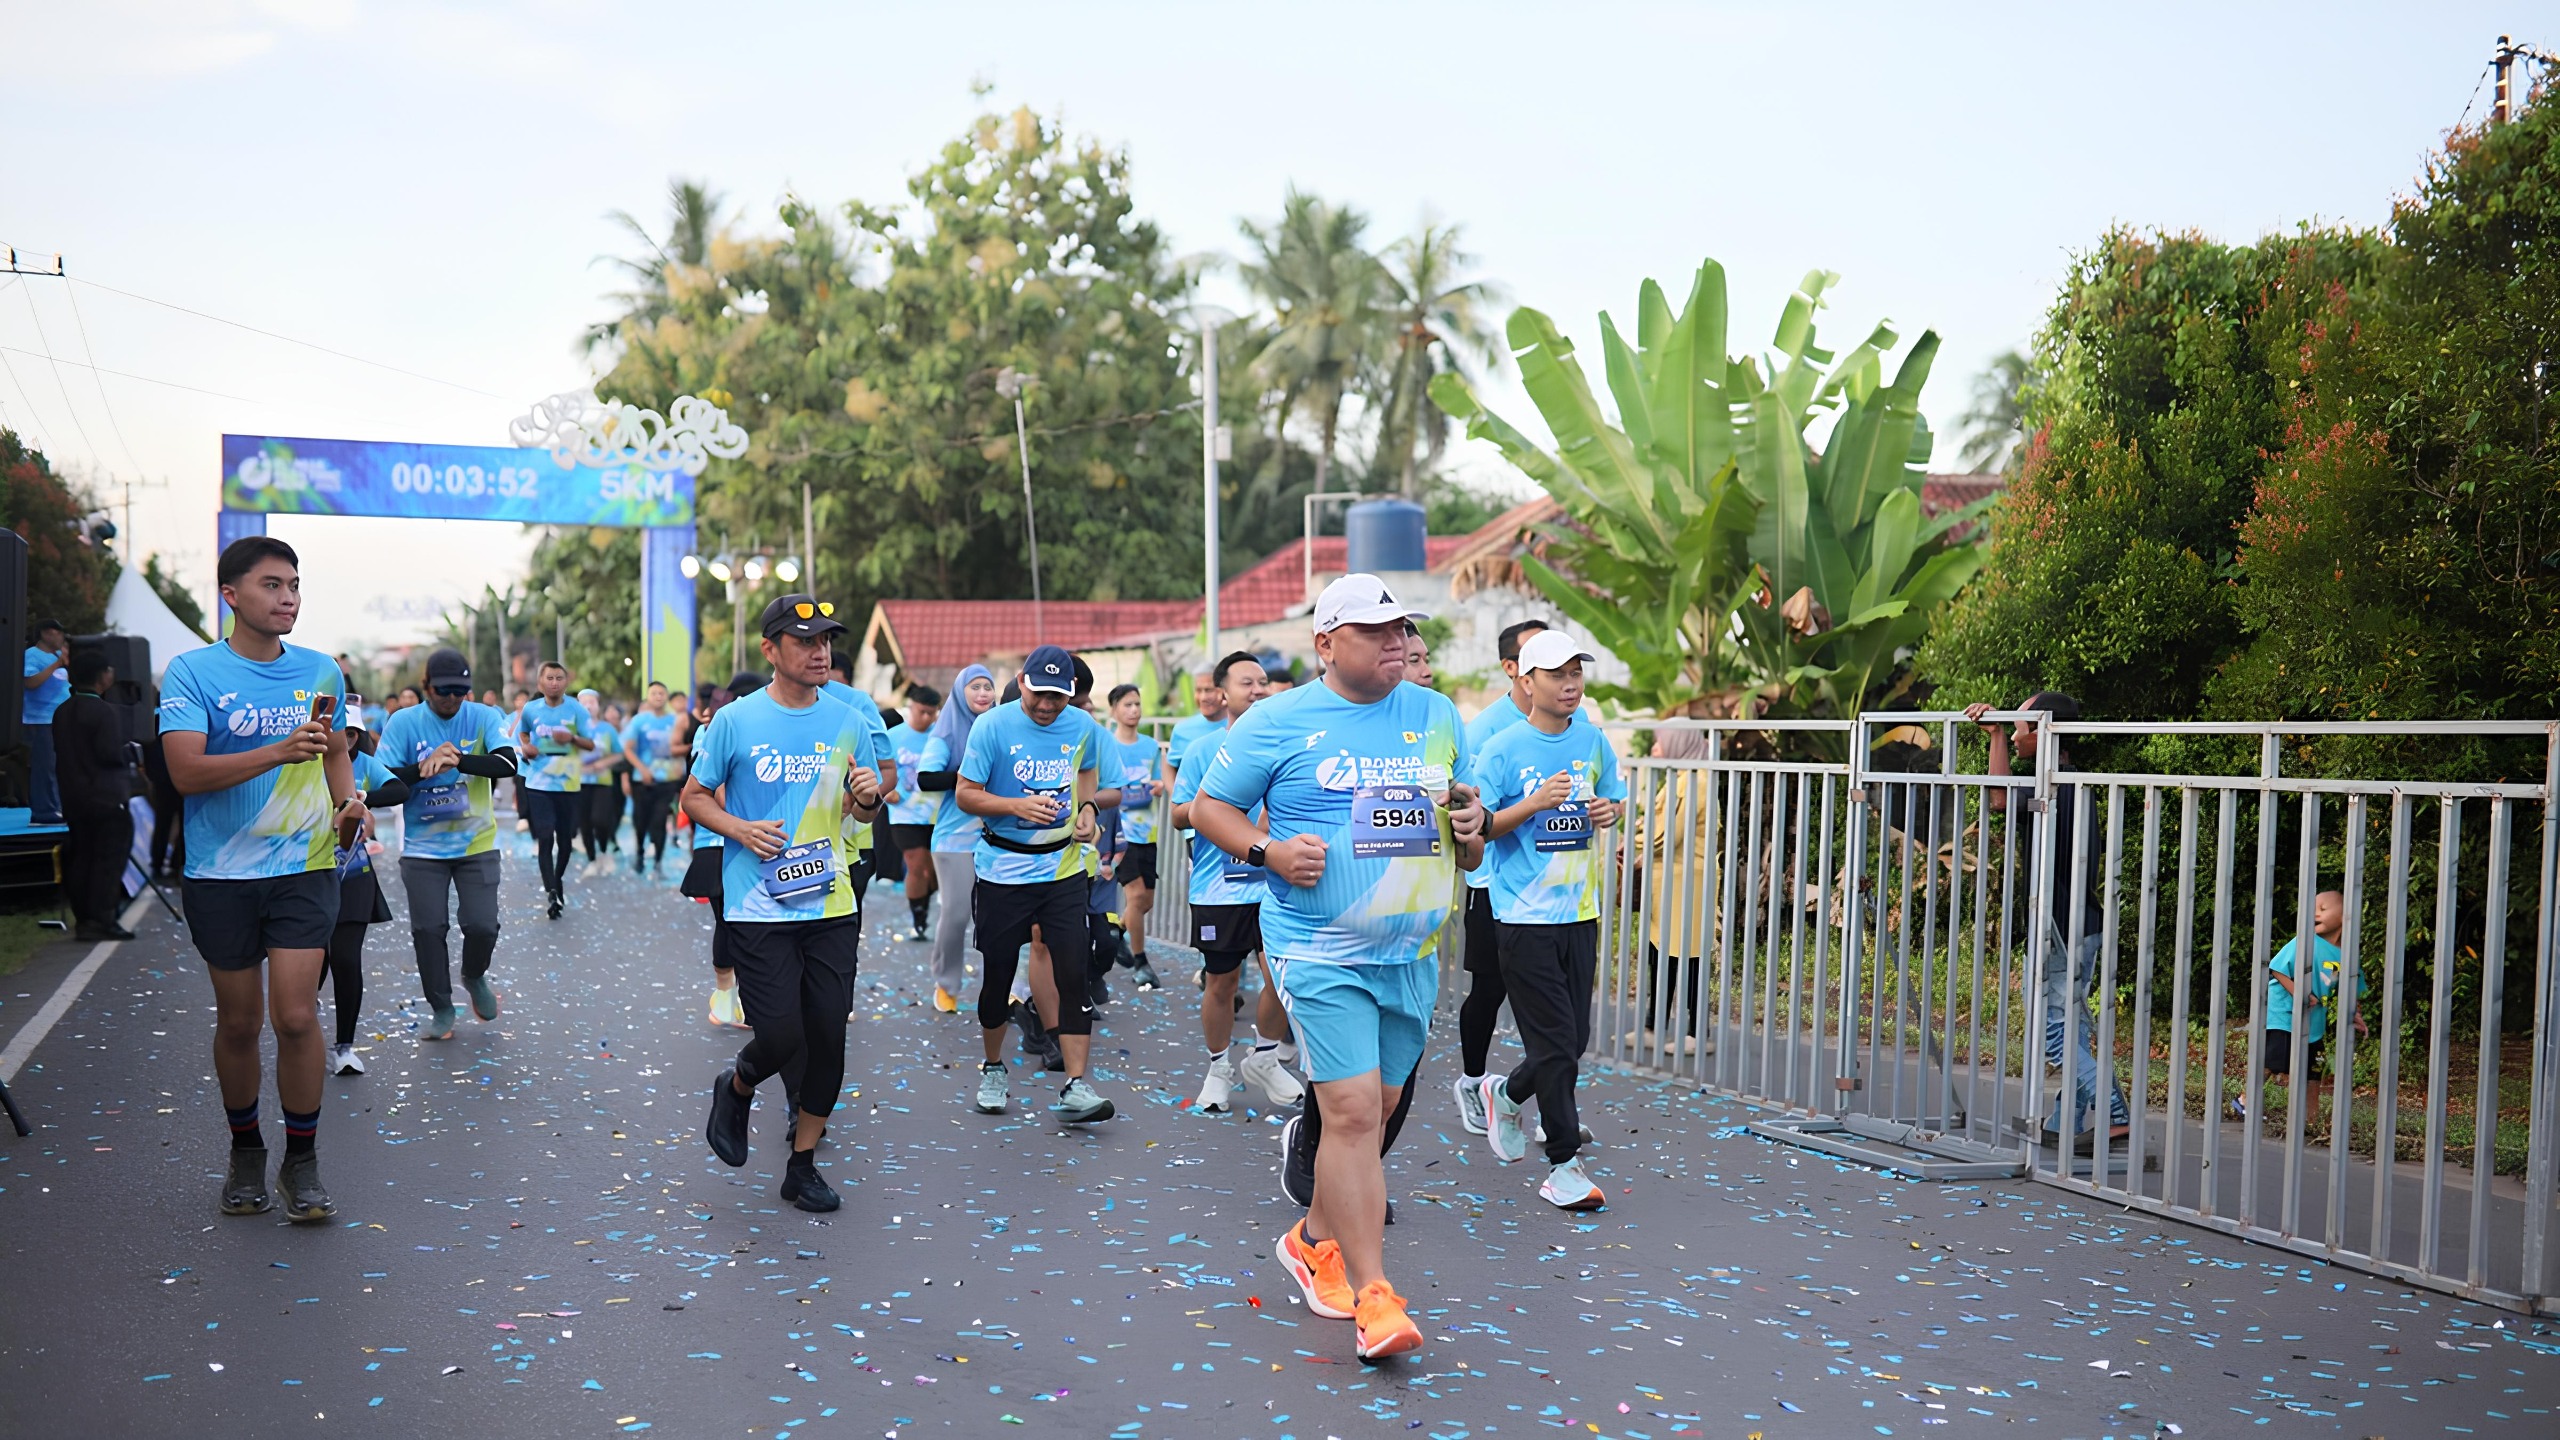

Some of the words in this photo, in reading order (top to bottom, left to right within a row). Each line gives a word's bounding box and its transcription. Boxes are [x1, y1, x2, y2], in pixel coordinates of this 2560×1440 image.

[391, 462, 538, 498] 00:03:52
[601, 470, 674, 502] 5KM
[1372, 809, 1425, 828] 5941
[777, 859, 825, 882] 6509
